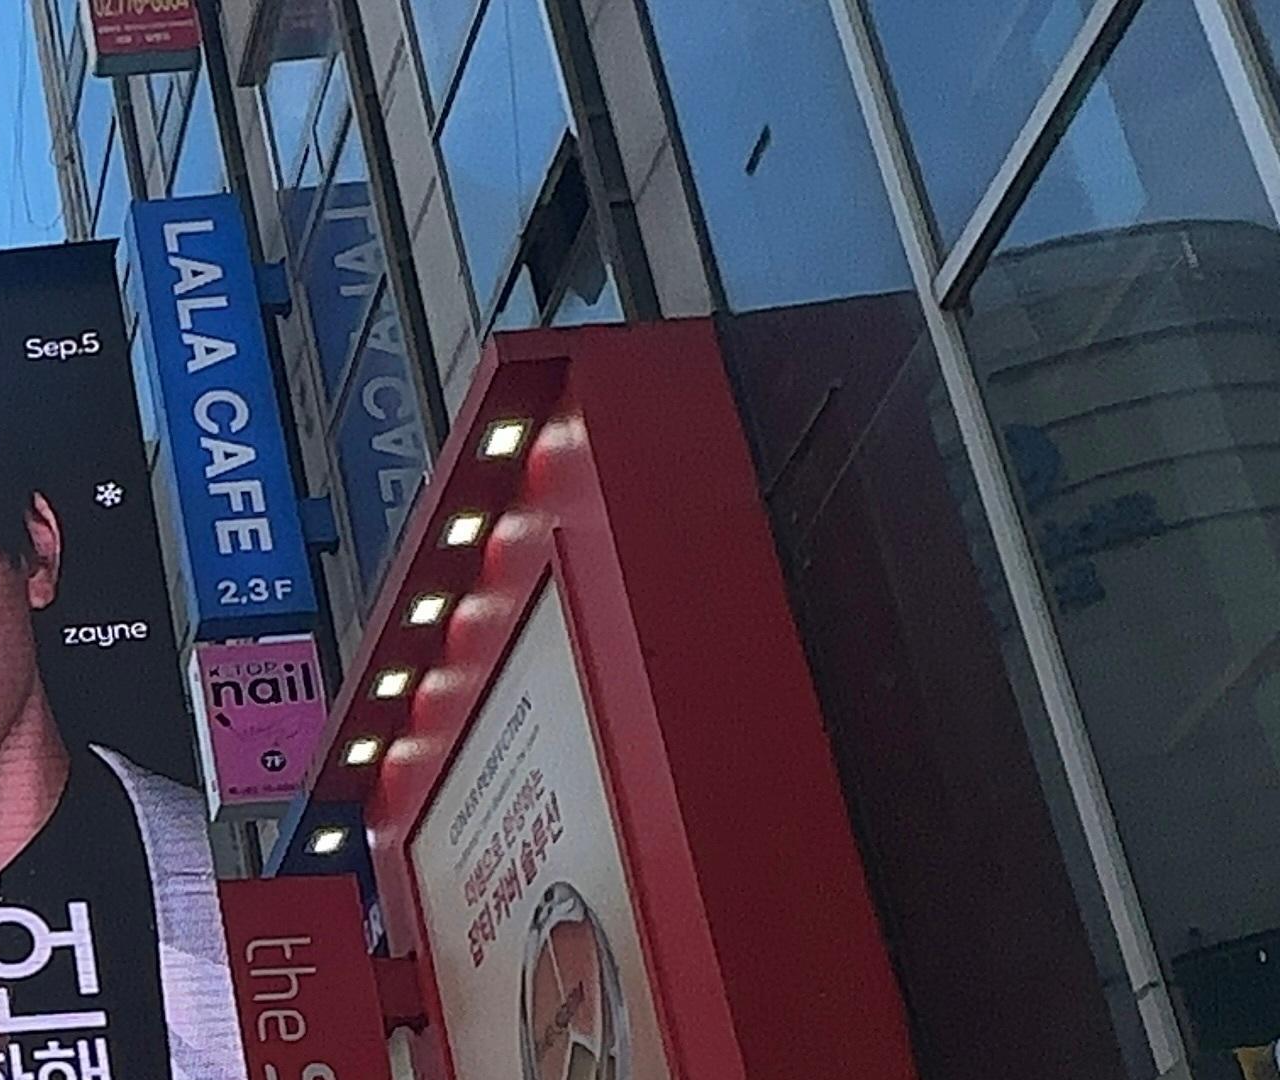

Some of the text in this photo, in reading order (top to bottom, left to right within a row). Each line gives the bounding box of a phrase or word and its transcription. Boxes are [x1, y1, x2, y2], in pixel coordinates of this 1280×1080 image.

[25, 332, 100, 360] Sep.5
[163, 219, 275, 555] LALA CAFE
[64, 619, 147, 647] zayne
[211, 661, 315, 707] nail
[247, 936, 317, 1045] the
